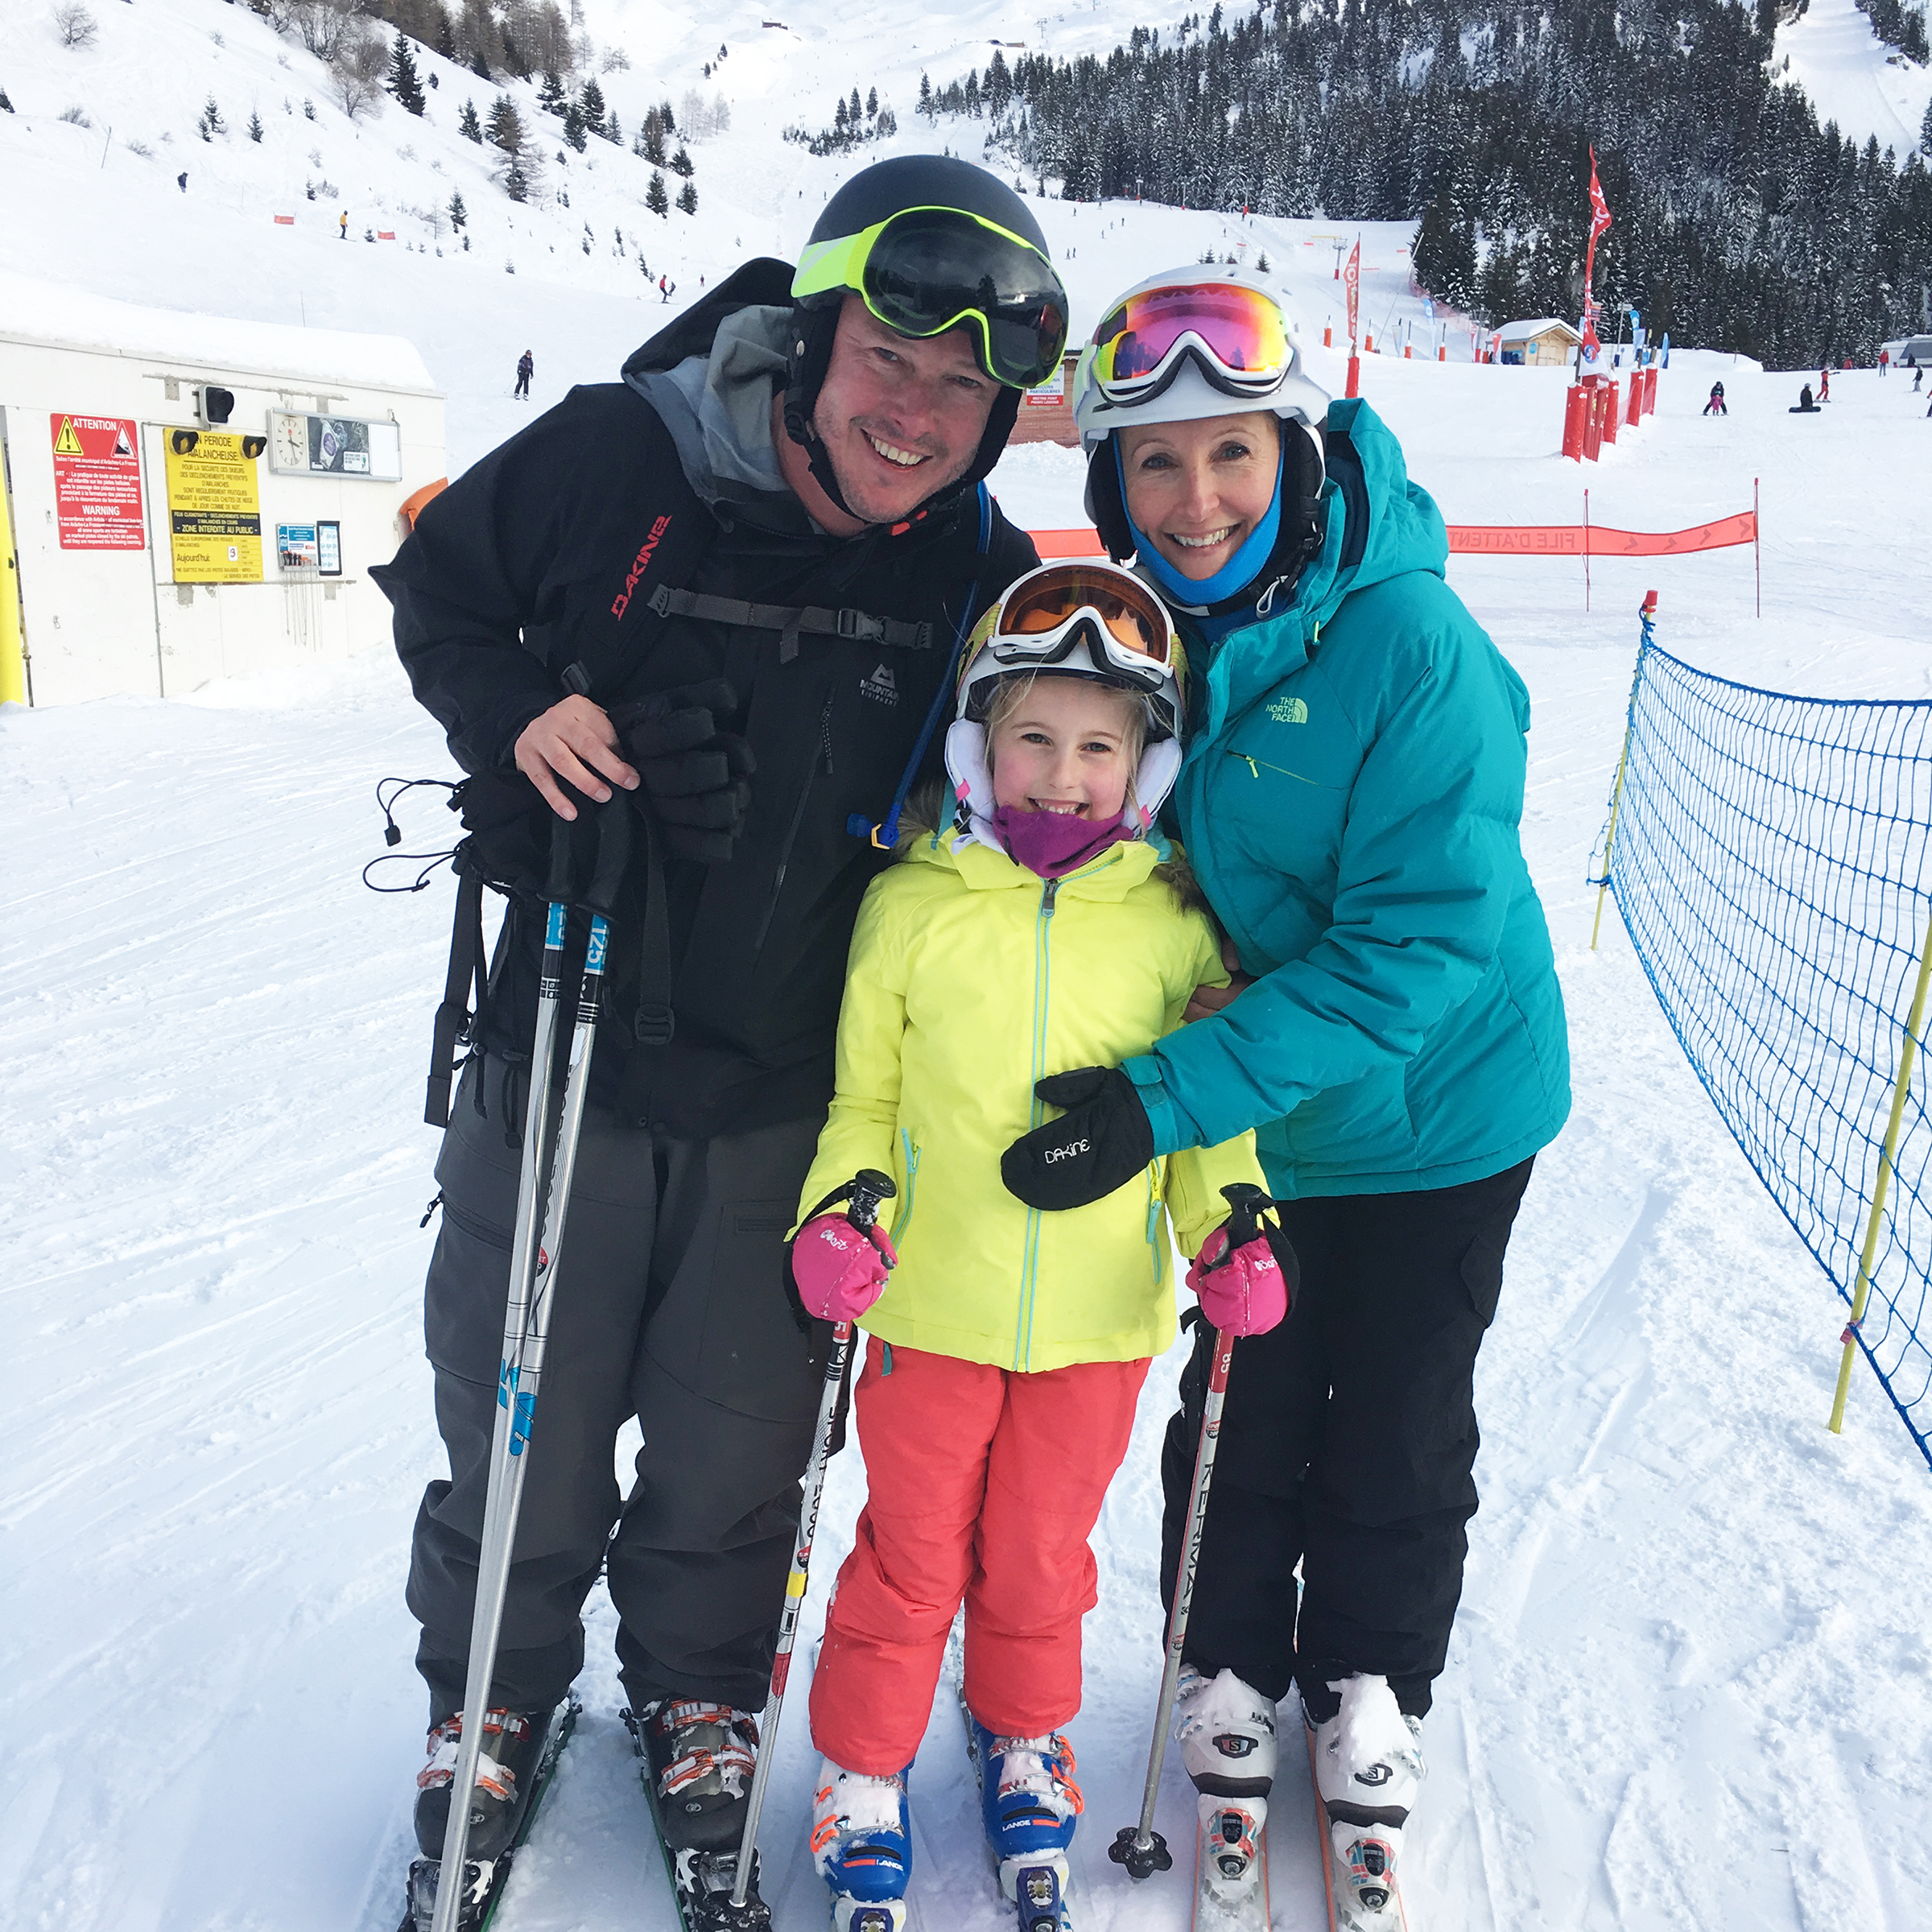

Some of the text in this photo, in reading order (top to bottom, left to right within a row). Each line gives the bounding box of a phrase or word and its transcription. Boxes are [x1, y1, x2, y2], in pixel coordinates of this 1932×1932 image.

[73, 418, 117, 431] ATTENTION
[204, 436, 232, 447] PERIODE
[188, 449, 238, 460] AVALANCHEUSE
[82, 505, 120, 515] WARNING
[182, 525, 197, 533] ZONE
[610, 515, 673, 622] DAKINE
[1280, 696, 1295, 706] THE
[1265, 704, 1294, 714] NORTH
[1271, 713, 1292, 723] FACE
[587, 924, 607, 964] 125
[1001, 1819, 1031, 1832] LANGE
